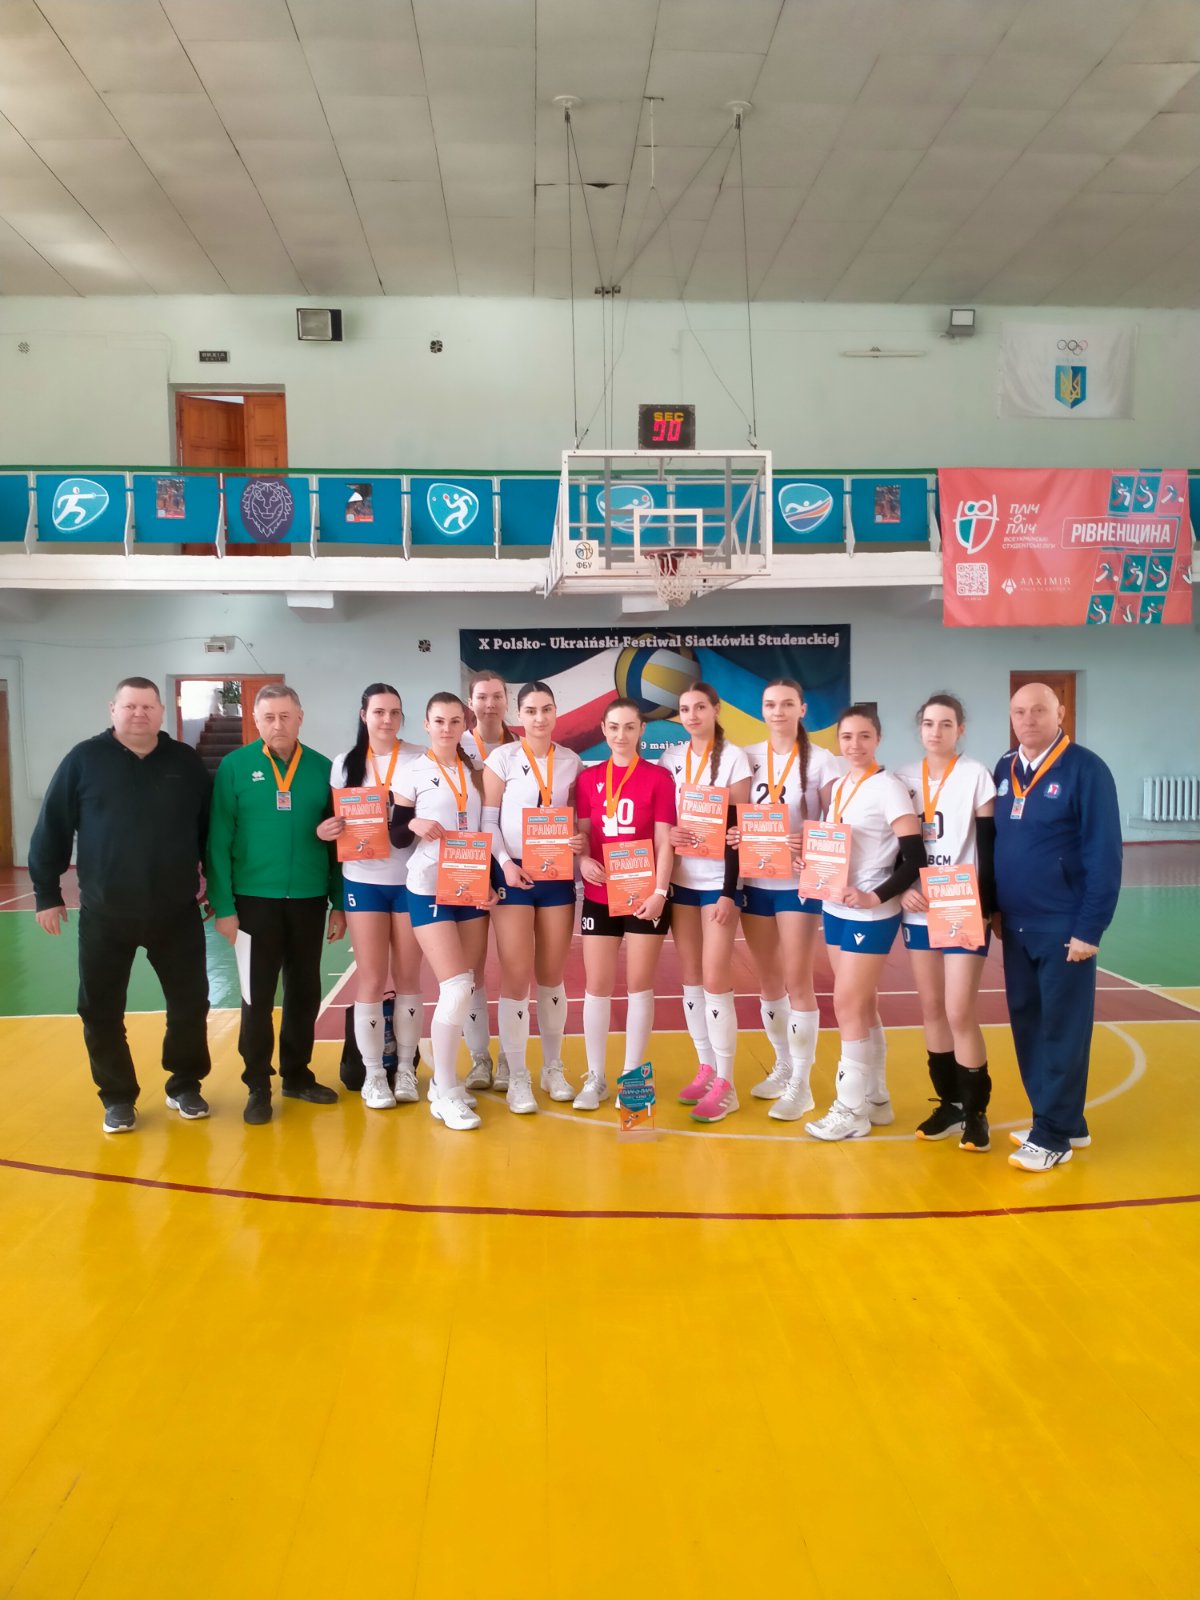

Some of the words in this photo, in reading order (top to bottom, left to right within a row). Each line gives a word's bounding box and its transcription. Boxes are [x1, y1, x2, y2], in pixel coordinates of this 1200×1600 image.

[653, 412, 684, 421] SEC
[1009, 503, 1040, 514] ПЛІЧ
[1006, 523, 1037, 534] ПЛІЧ
[1071, 522, 1170, 544] РІВНЕНЩИНА
[576, 561, 592, 569] ФБУ
[478, 638, 490, 650] X
[493, 638, 546, 650] Polsko-
[550, 636, 619, 649] Ukraiński
[622, 635, 681, 648] Festiwal
[685, 634, 755, 647] Siatkówki
[758, 633, 840, 648] Studenckiej
[340, 803, 382, 816] ГРАМОТА
[682, 800, 723, 815] ГРАМОТА
[526, 824, 569, 835] ГРАМОТА
[742, 820, 785, 832] ГРАМОТА
[443, 847, 487, 860] ГРАМОТА
[609, 857, 651, 871] ГРАМОТА
[498, 887, 506, 899] 6
[927, 883, 974, 898] ГРАМОТА
[347, 893, 357, 907] 5
[428, 904, 438, 917] 7
[581, 917, 595, 931] 30
[645, 1102, 652, 1117] 1
